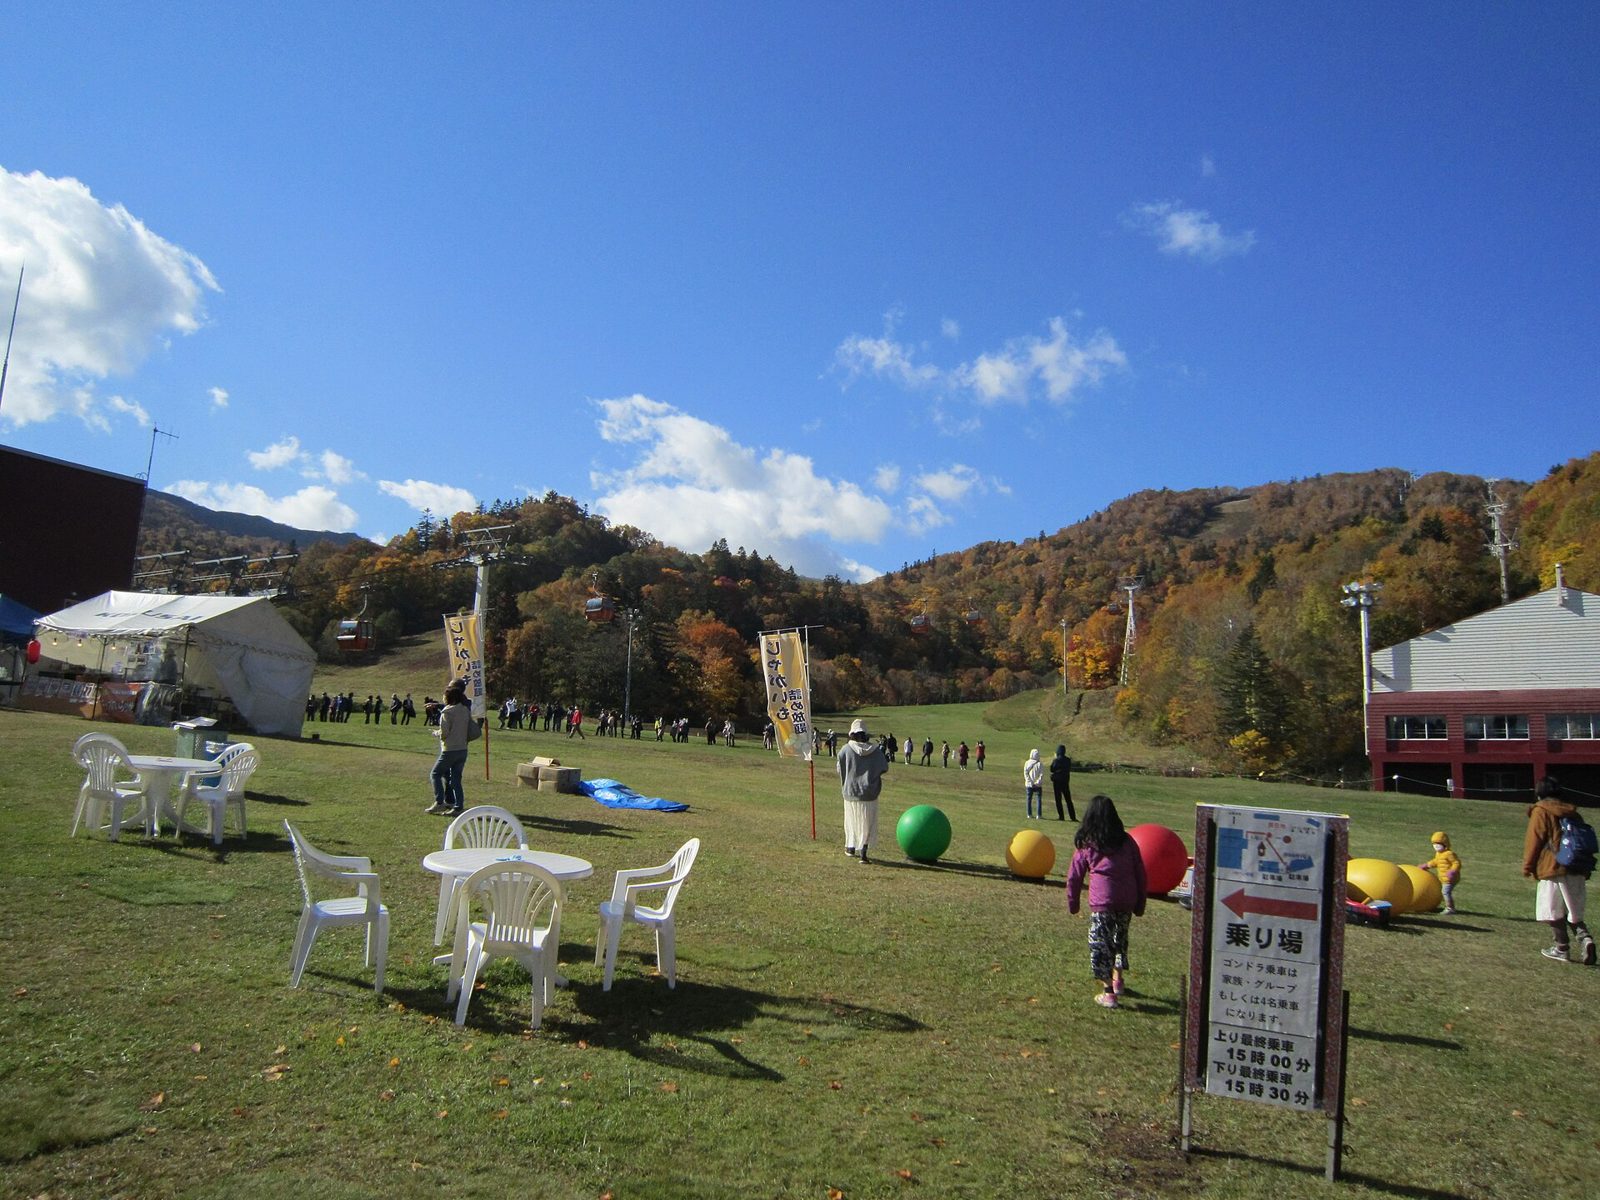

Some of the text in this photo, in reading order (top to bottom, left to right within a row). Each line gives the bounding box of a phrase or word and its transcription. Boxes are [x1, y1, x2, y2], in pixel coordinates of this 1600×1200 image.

[1225, 922, 1304, 954] 乗り場
[1223, 958, 1298, 978] ゴンドラ乗車は
[1221, 974, 1298, 994] 家族・グループ
[1218, 990, 1300, 1011] もしくは4名乗車
[1225, 1008, 1284, 1026] になります。
[1214, 1029, 1295, 1053] 上り最終乗車
[1212, 1060, 1294, 1086] 下り最終乗車
